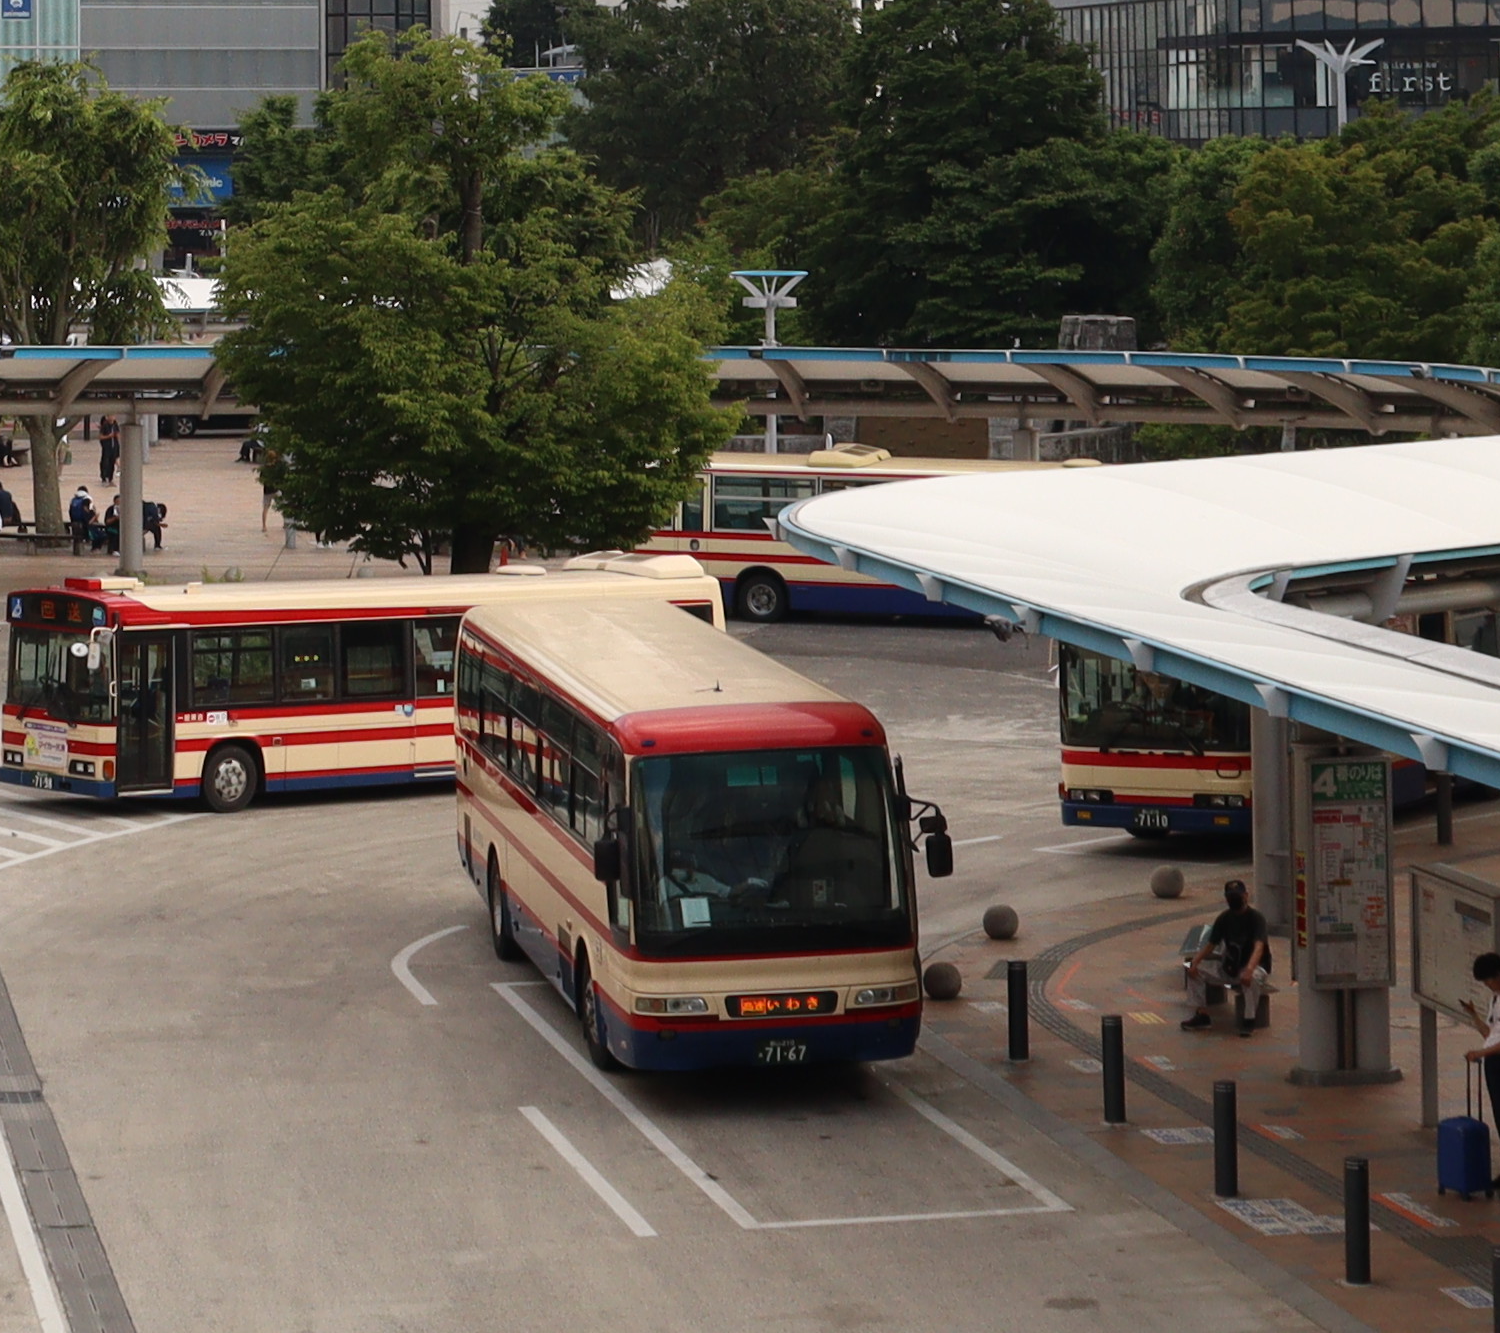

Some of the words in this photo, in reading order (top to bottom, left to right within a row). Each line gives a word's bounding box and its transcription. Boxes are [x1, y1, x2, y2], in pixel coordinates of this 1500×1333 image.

[1368, 71, 1452, 94] first
[767, 996, 819, 1011] いわき
